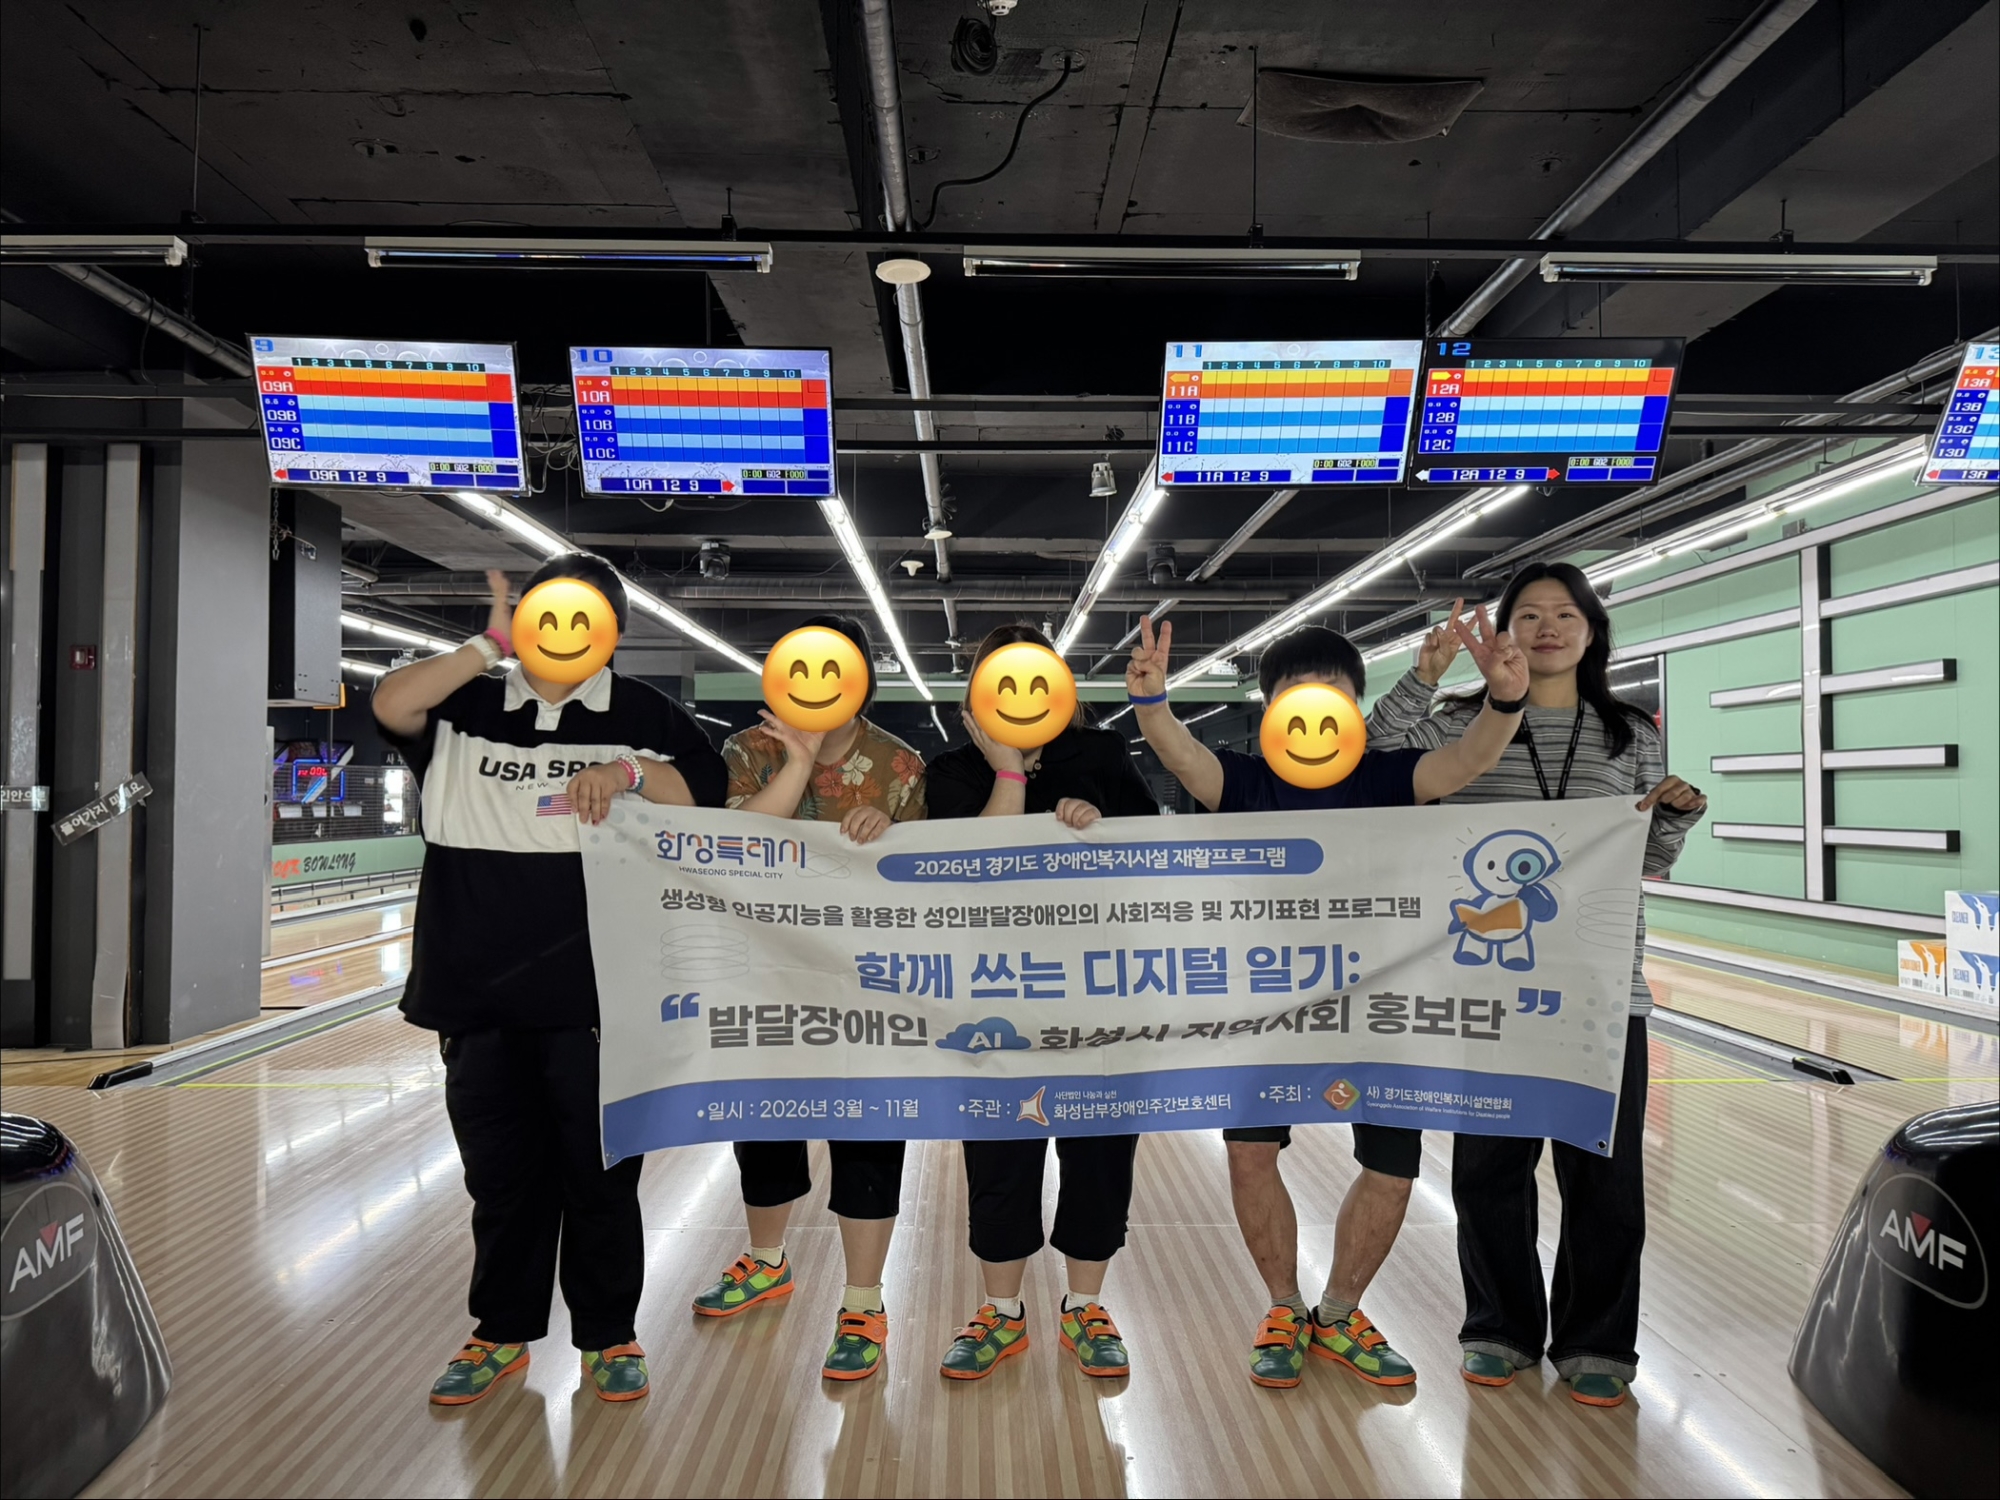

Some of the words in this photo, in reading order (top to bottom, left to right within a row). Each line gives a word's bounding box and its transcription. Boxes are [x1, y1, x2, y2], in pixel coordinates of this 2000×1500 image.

[1437, 342, 1471, 356] 12
[579, 349, 613, 363] 10
[312, 359, 319, 367] 2
[327, 359, 334, 367] 3
[385, 361, 393, 369] 6
[426, 362, 433, 370] 8
[466, 363, 480, 371] 10
[1207, 361, 1212, 369] 1
[1221, 361, 1229, 369] 2
[1236, 361, 1243, 369] 3
[1253, 361, 1261, 369] 4
[1274, 361, 1281, 369] 5
[1293, 361, 1301, 369] 6
[1372, 360, 1385, 368] 10
[1470, 360, 1475, 368] 1
[1484, 360, 1491, 368] 2
[1499, 360, 1507, 368] 3
[1516, 360, 1523, 368] 4
[1536, 360, 1543, 368] 5
[1556, 360, 1563, 368] 6
[1575, 360, 1583, 368] 7
[645, 368, 652, 376] 3
[662, 368, 669, 376] 4
[703, 369, 710, 377] 6
[723, 369, 730, 377] 7
[743, 369, 750, 377] 8
[783, 370, 795, 378] 10
[262, 381, 294, 393] 09A
[1963, 378, 1990, 387] 13A
[1169, 385, 1198, 397] 11A
[1431, 384, 1459, 395] 12A
[580, 391, 610, 403] 10A
[1955, 403, 1982, 411] 13B
[266, 410, 297, 422] 09B
[1167, 414, 1196, 425] 11B
[1427, 412, 1455, 423] 12B
[584, 419, 613, 431] 10B
[1946, 425, 1973, 434] 13C
[270, 437, 301, 450] 09C
[1166, 441, 1194, 452] 11C
[1424, 439, 1451, 450] 12C
[587, 448, 616, 459] 10C
[1938, 448, 1965, 457] 13D
[309, 470, 340, 482] 09A
[349, 471, 367, 482] 12
[376, 472, 387, 482] 9
[1196, 471, 1224, 482] 11A
[1233, 471, 1251, 482] 12
[1259, 471, 1270, 481] 9
[1452, 470, 1479, 480] 12A
[1489, 470, 1507, 480] 12
[1515, 470, 1525, 480] 9
[1961, 470, 1988, 479] 13A
[624, 479, 653, 490] 10A
[661, 479, 679, 491] 12
[689, 480, 700, 491] 9
[479, 756, 536, 782] USA
[516, 782, 548, 791] NEW
[303, 852, 356, 873] BOWLING
[915, 859, 981, 877] 2026년
[985, 854, 1038, 876] 경기도
[1043, 849, 1168, 872] 장애인복지시설
[1173, 847, 1286, 869] 재활프로그램
[679, 866, 727, 876] HWASEONG
[729, 869, 762, 878] SPECIAL
[660, 888, 728, 913] 생성형
[732, 902, 844, 927] 인공지능을
[850, 906, 916, 928] 활용한
[923, 903, 1099, 928] 성인발달장애인의
[1106, 901, 1194, 924] 사회적응
[1202, 900, 1223, 922] 및
[1230, 898, 1320, 921] 자기표현
[1328, 897, 1421, 919] 프로그램
[855, 951, 954, 1000] 함께
[970, 951, 1066, 999] 쓰는
[1083, 947, 1228, 998] 디지털
[1246, 943, 1361, 994] 일기:
[967, 1032, 1001, 1049] AI
[1040, 1024, 1170, 1050] 화성시
[1181, 995, 1351, 1035] 지역사회
[1366, 1086, 1380, 1099] 사)
[1384, 1087, 1513, 1111] 경기도장애인복지시설연합회
[760, 1100, 827, 1118] 2026년
[833, 1099, 863, 1118] 3월
[885, 1099, 919, 1118] 11월
[1053, 1093, 1231, 1120] 화성남부장애인주간보호센터
[1879, 1208, 1967, 1271] AMF
[9, 1212, 84, 1293] AMF
